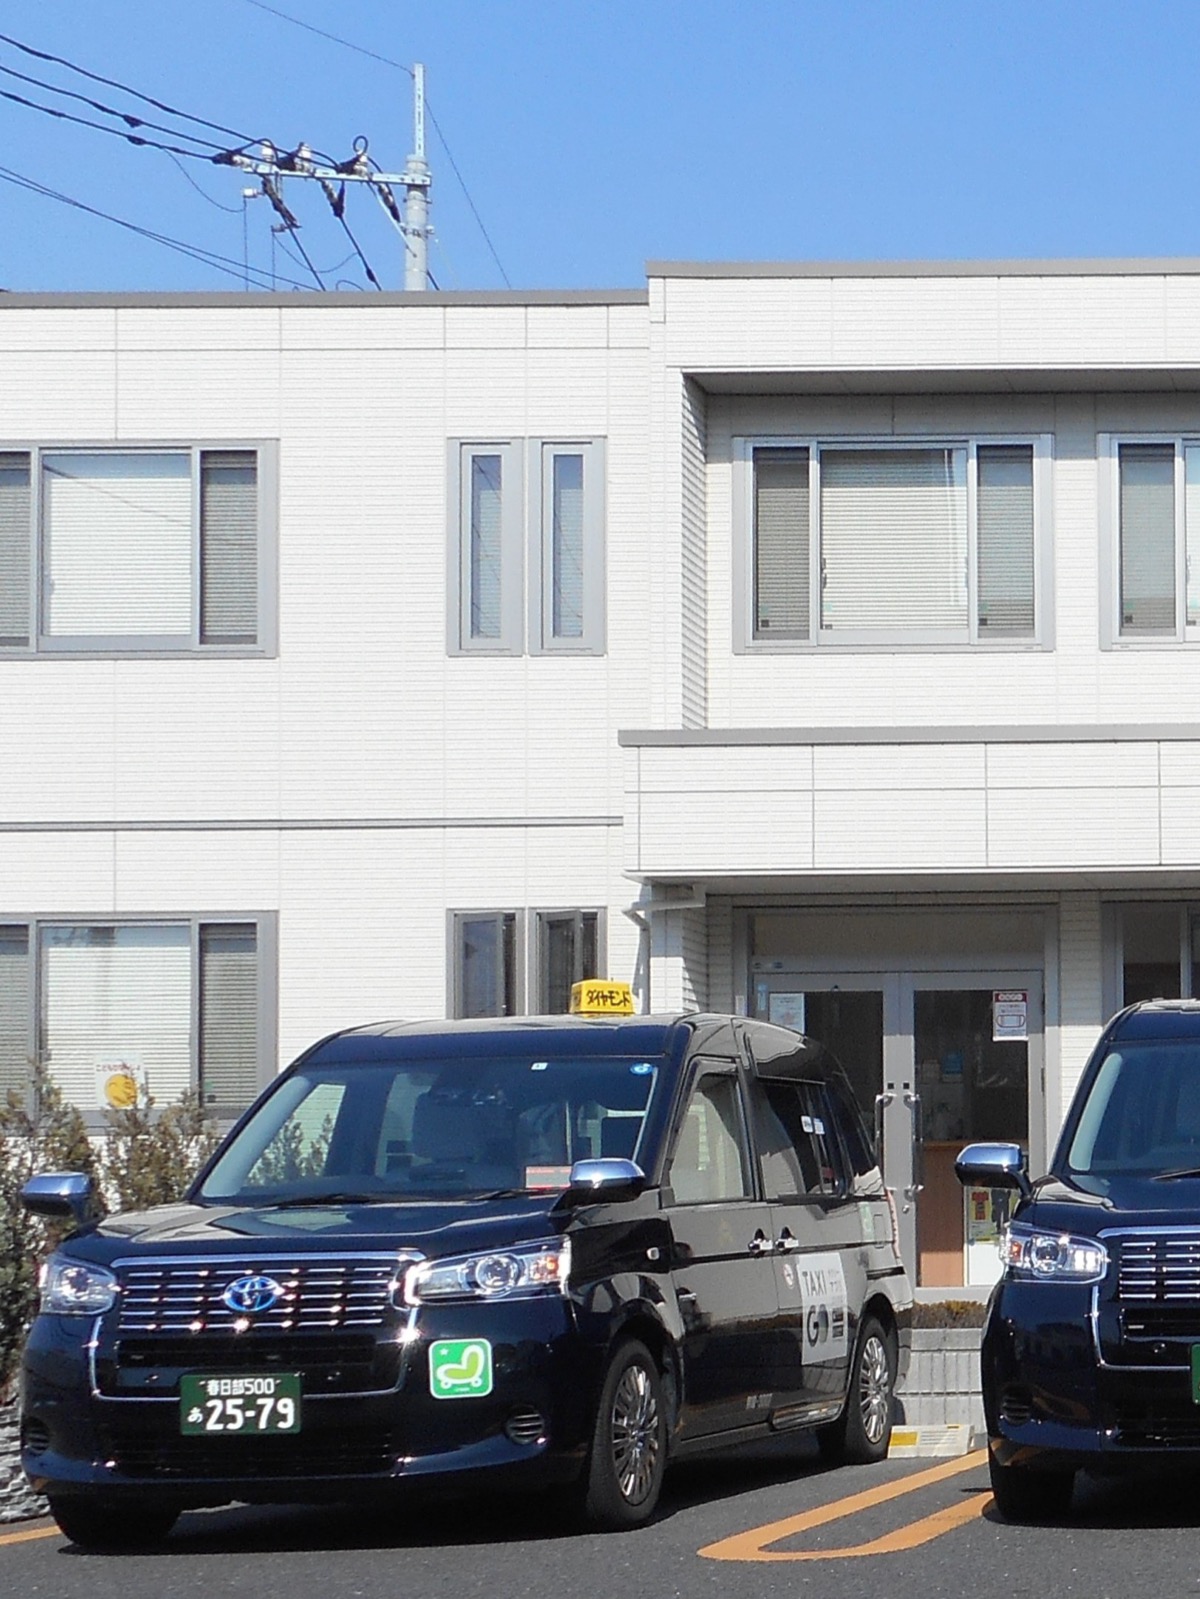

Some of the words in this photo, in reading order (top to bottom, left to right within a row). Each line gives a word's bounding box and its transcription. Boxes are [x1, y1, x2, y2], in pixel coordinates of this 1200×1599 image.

[802, 1270, 828, 1296] TAXI
[187, 1406, 204, 1423] あ
[205, 1397, 295, 1430] 25-79
